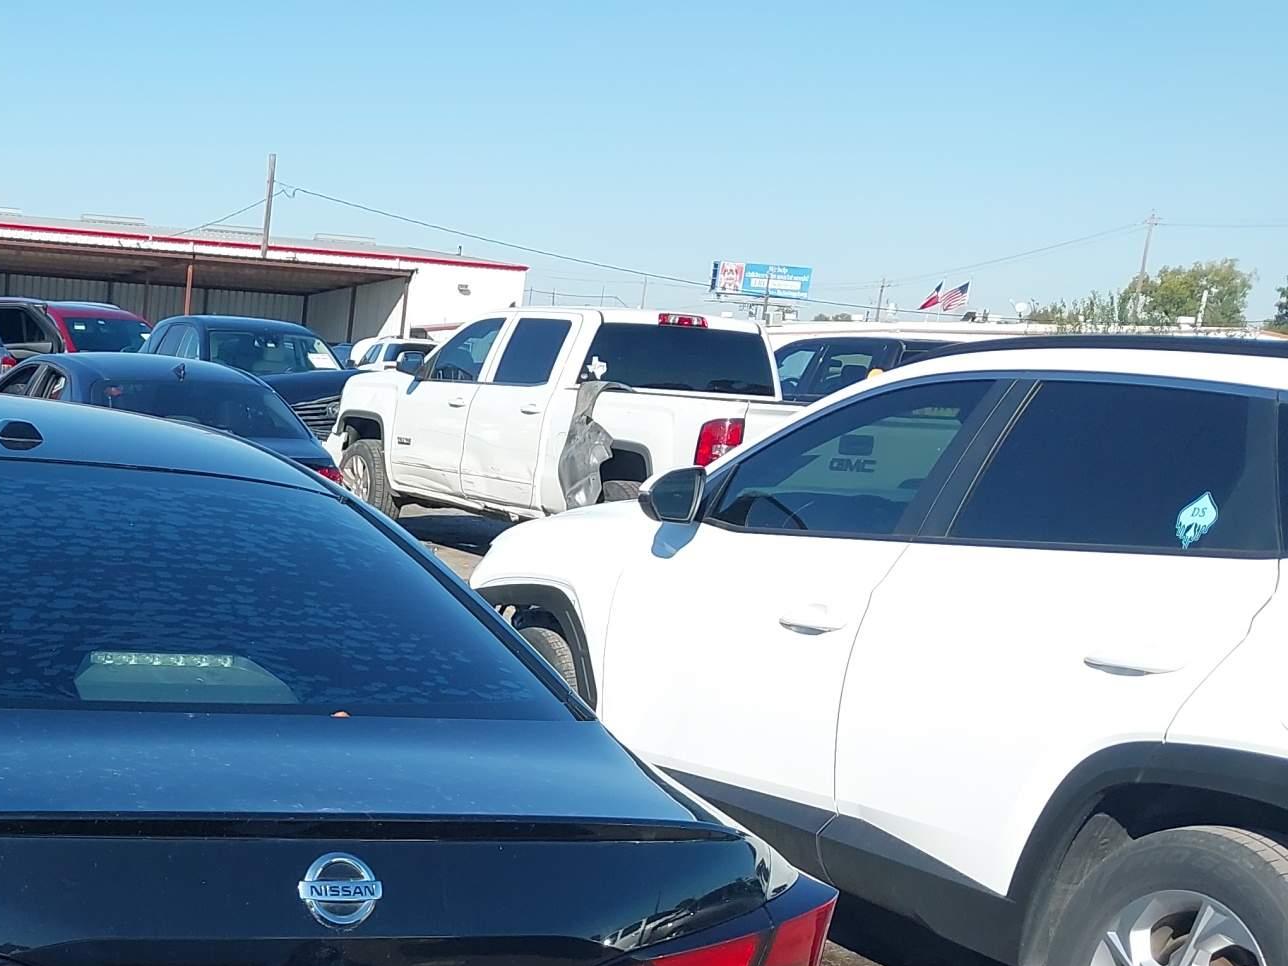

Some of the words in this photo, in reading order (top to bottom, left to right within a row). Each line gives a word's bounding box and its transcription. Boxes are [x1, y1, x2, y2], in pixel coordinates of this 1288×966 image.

[829, 458, 877, 472] GMC
[1192, 507, 1208, 518] DS
[310, 885, 376, 897] NISSAN
